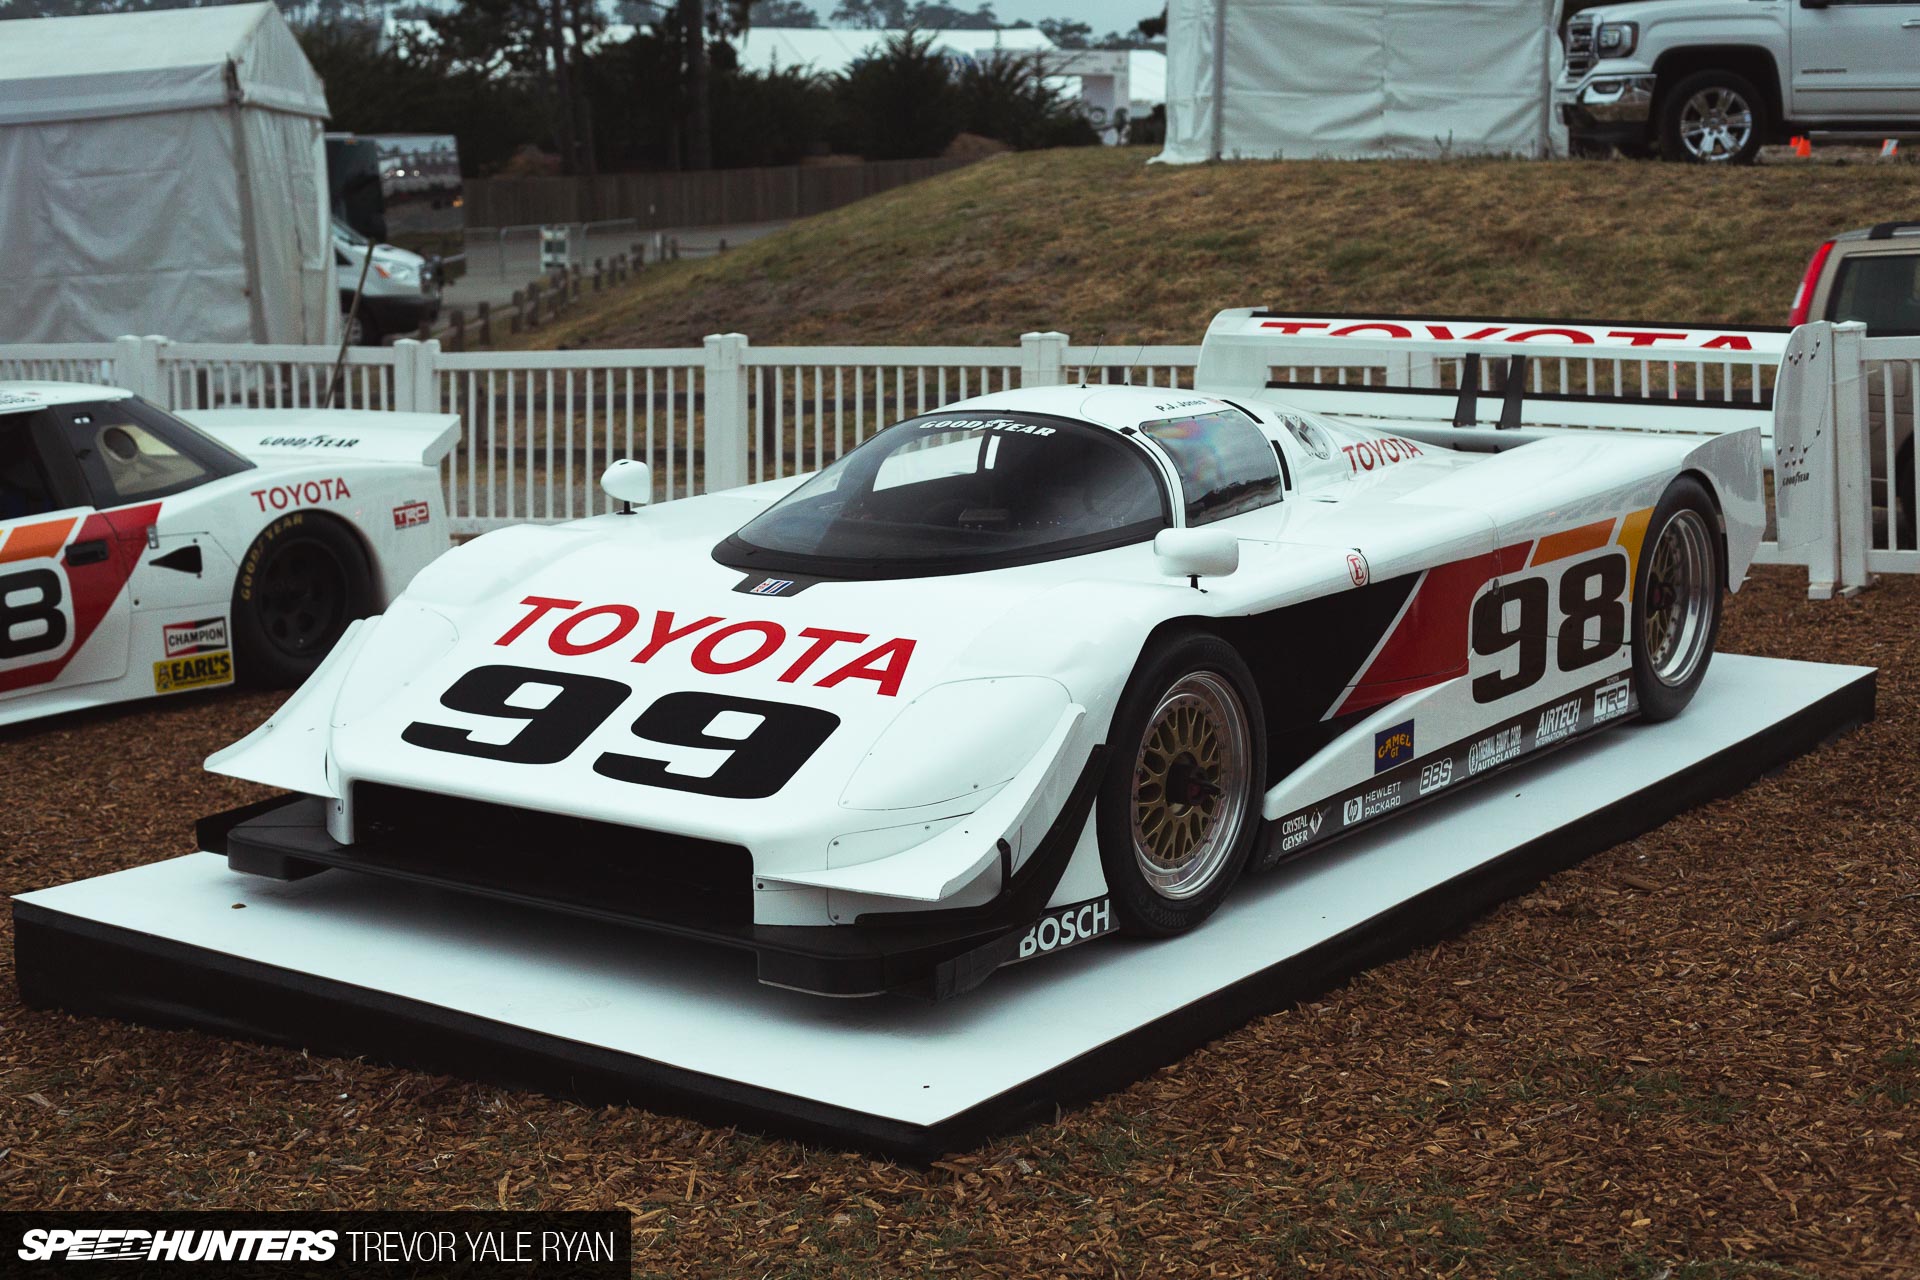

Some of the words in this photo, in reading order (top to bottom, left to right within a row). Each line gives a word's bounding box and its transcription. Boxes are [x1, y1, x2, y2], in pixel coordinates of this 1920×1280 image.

[258, 434, 360, 448] GOODYEAR
[919, 418, 1057, 437] GOODYEAR
[1341, 438, 1424, 474] TOYOTA
[1782, 471, 1810, 487] GOODYEAR
[251, 477, 351, 512] TOYOTA
[394, 505, 428, 525] TRD
[168, 627, 224, 647] CHAMPION
[1472, 553, 1627, 704] 98
[493, 595, 918, 697] TOYOTA
[171, 653, 231, 681] EARL'S
[1596, 684, 1628, 715] TRD
[1536, 697, 1582, 739] AIRTECH
[401, 664, 841, 800] 99
[1377, 732, 1412, 759] CAMEL
[1535, 726, 1568, 748] INTERNATIONAL
[1390, 746, 1399, 759] GT
[1477, 746, 1521, 773] AUTOCLAVES
[1420, 757, 1453, 795] BBS
[1365, 781, 1402, 804] HEWLETT
[1364, 795, 1401, 818] PACKARD
[1282, 814, 1308, 836] CRYSTAL
[1282, 830, 1308, 851] GEYSER
[1019, 898, 1110, 958] BOSCH
